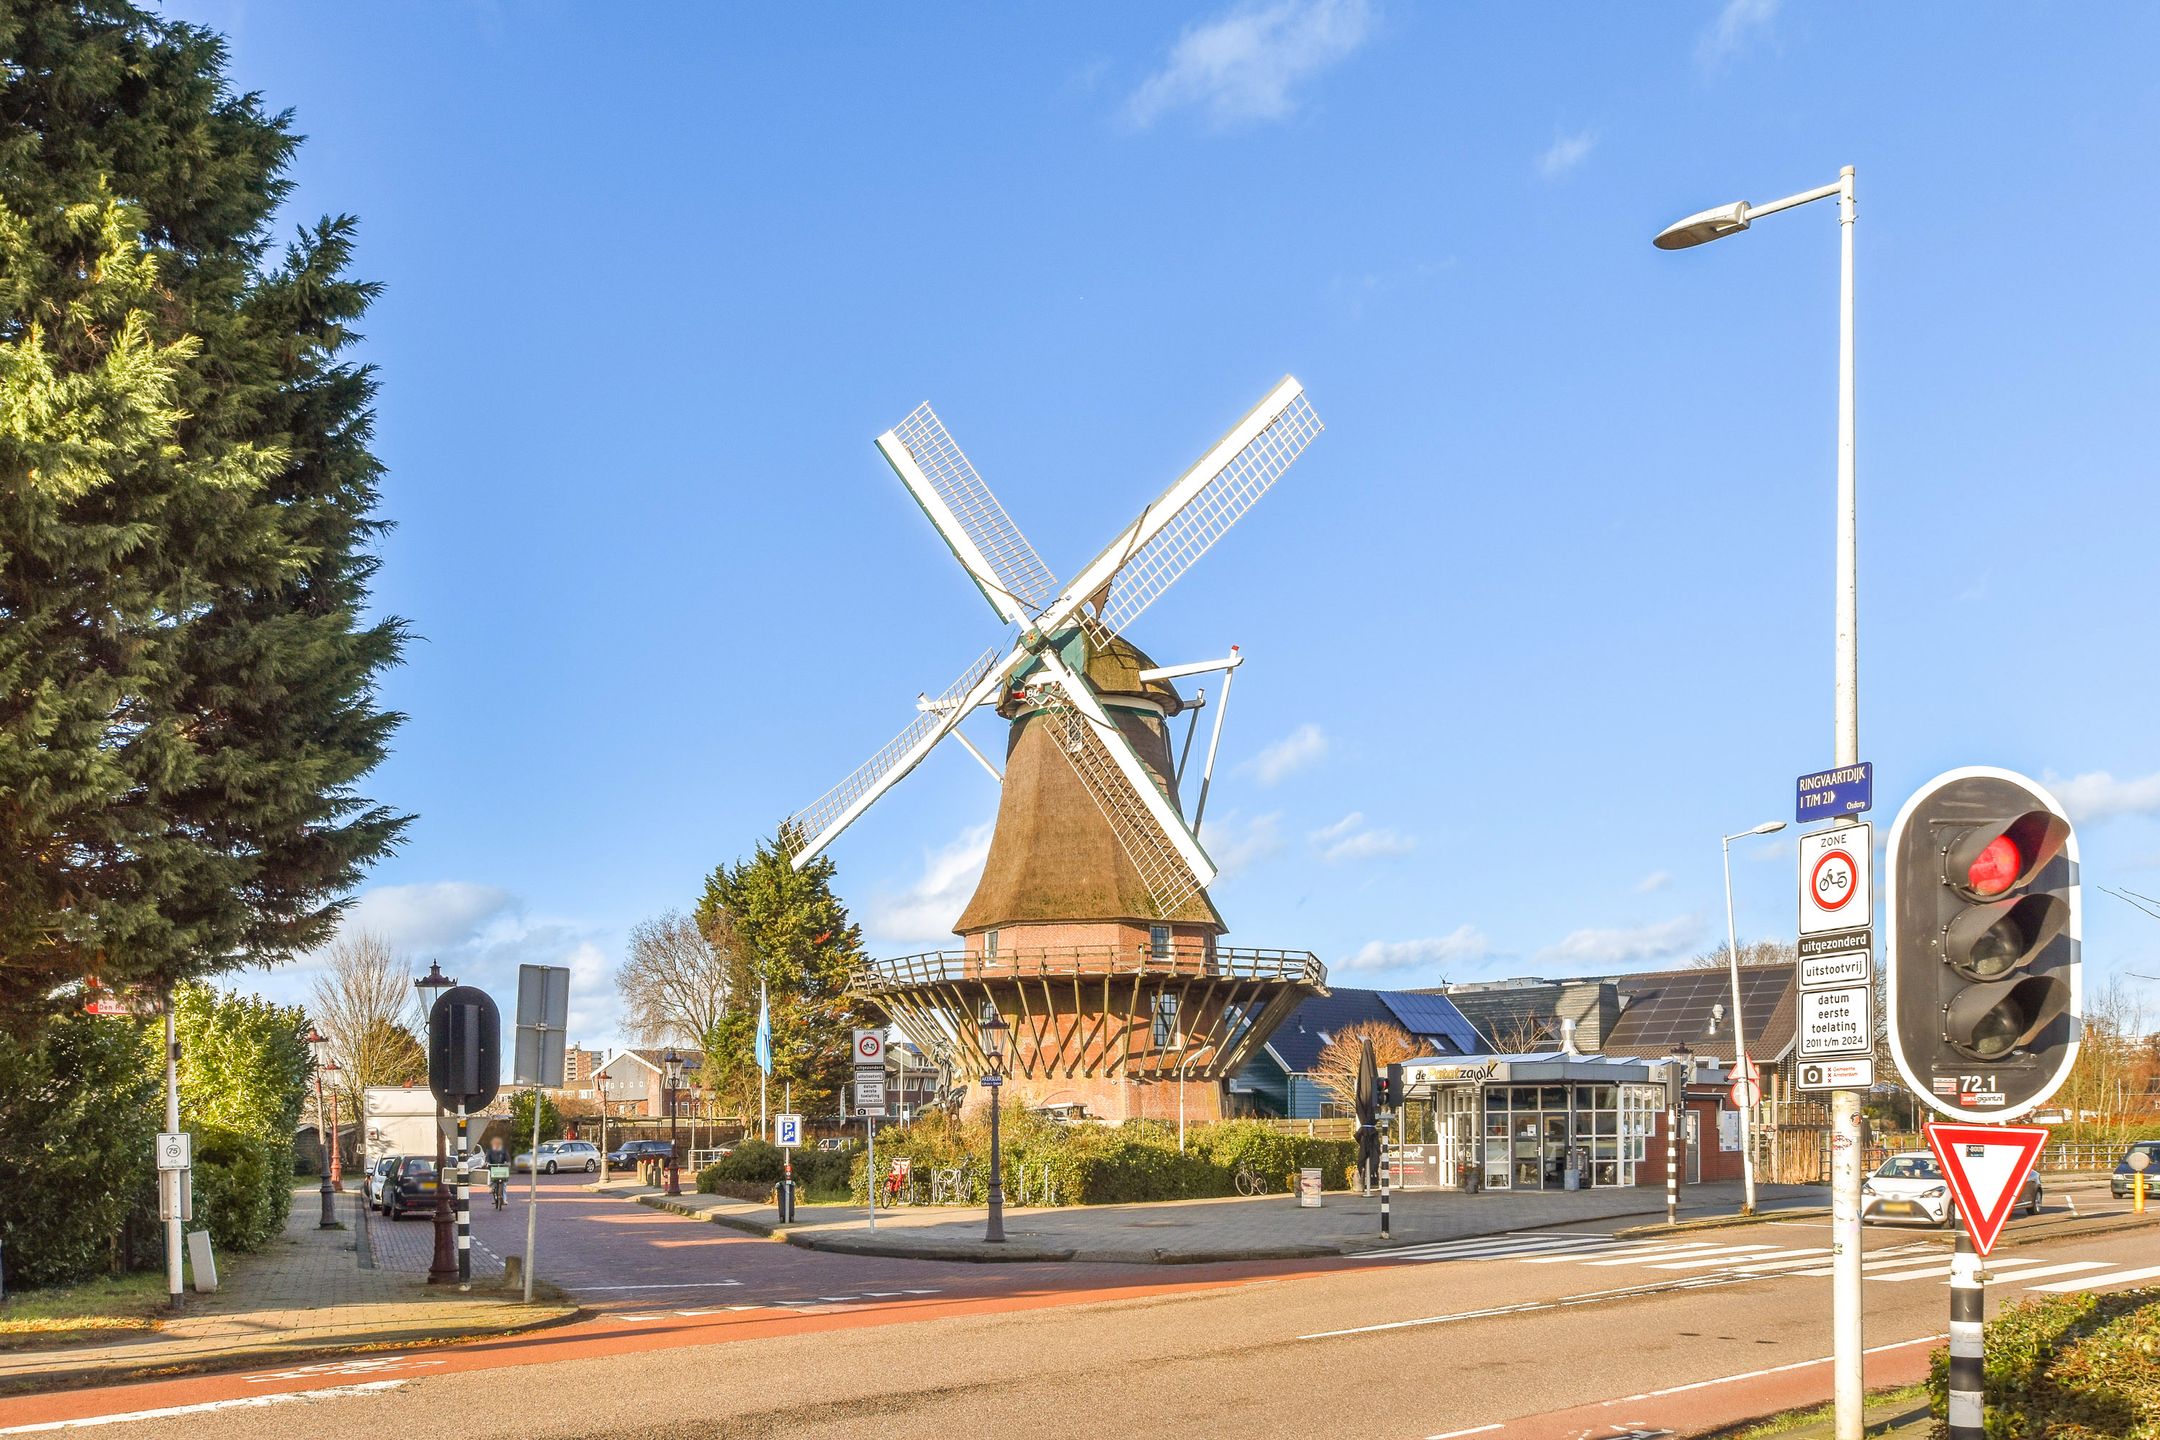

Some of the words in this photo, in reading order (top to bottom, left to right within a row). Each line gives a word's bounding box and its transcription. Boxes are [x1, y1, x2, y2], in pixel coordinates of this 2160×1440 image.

[1800, 766, 1865, 791] RINGVAARTDIJK
[1805, 794, 1820, 807] T/M
[1847, 801, 1865, 810] Osdorp
[1821, 834, 1847, 848] ZONE
[1802, 934, 1867, 953] uitgezonderd
[1806, 961, 1862, 977] uitstootvrij
[1818, 995, 1849, 1005] datum
[1818, 1008, 1849, 1019] eerste
[1812, 1021, 1856, 1034] toelating
[1806, 1038, 1822, 1048] 2011
[1824, 1037, 1839, 1047] t/m
[1842, 1035, 1863, 1046] 2024
[1416, 1068, 1426, 1080] de
[1960, 1075, 1996, 1092] 72.1
